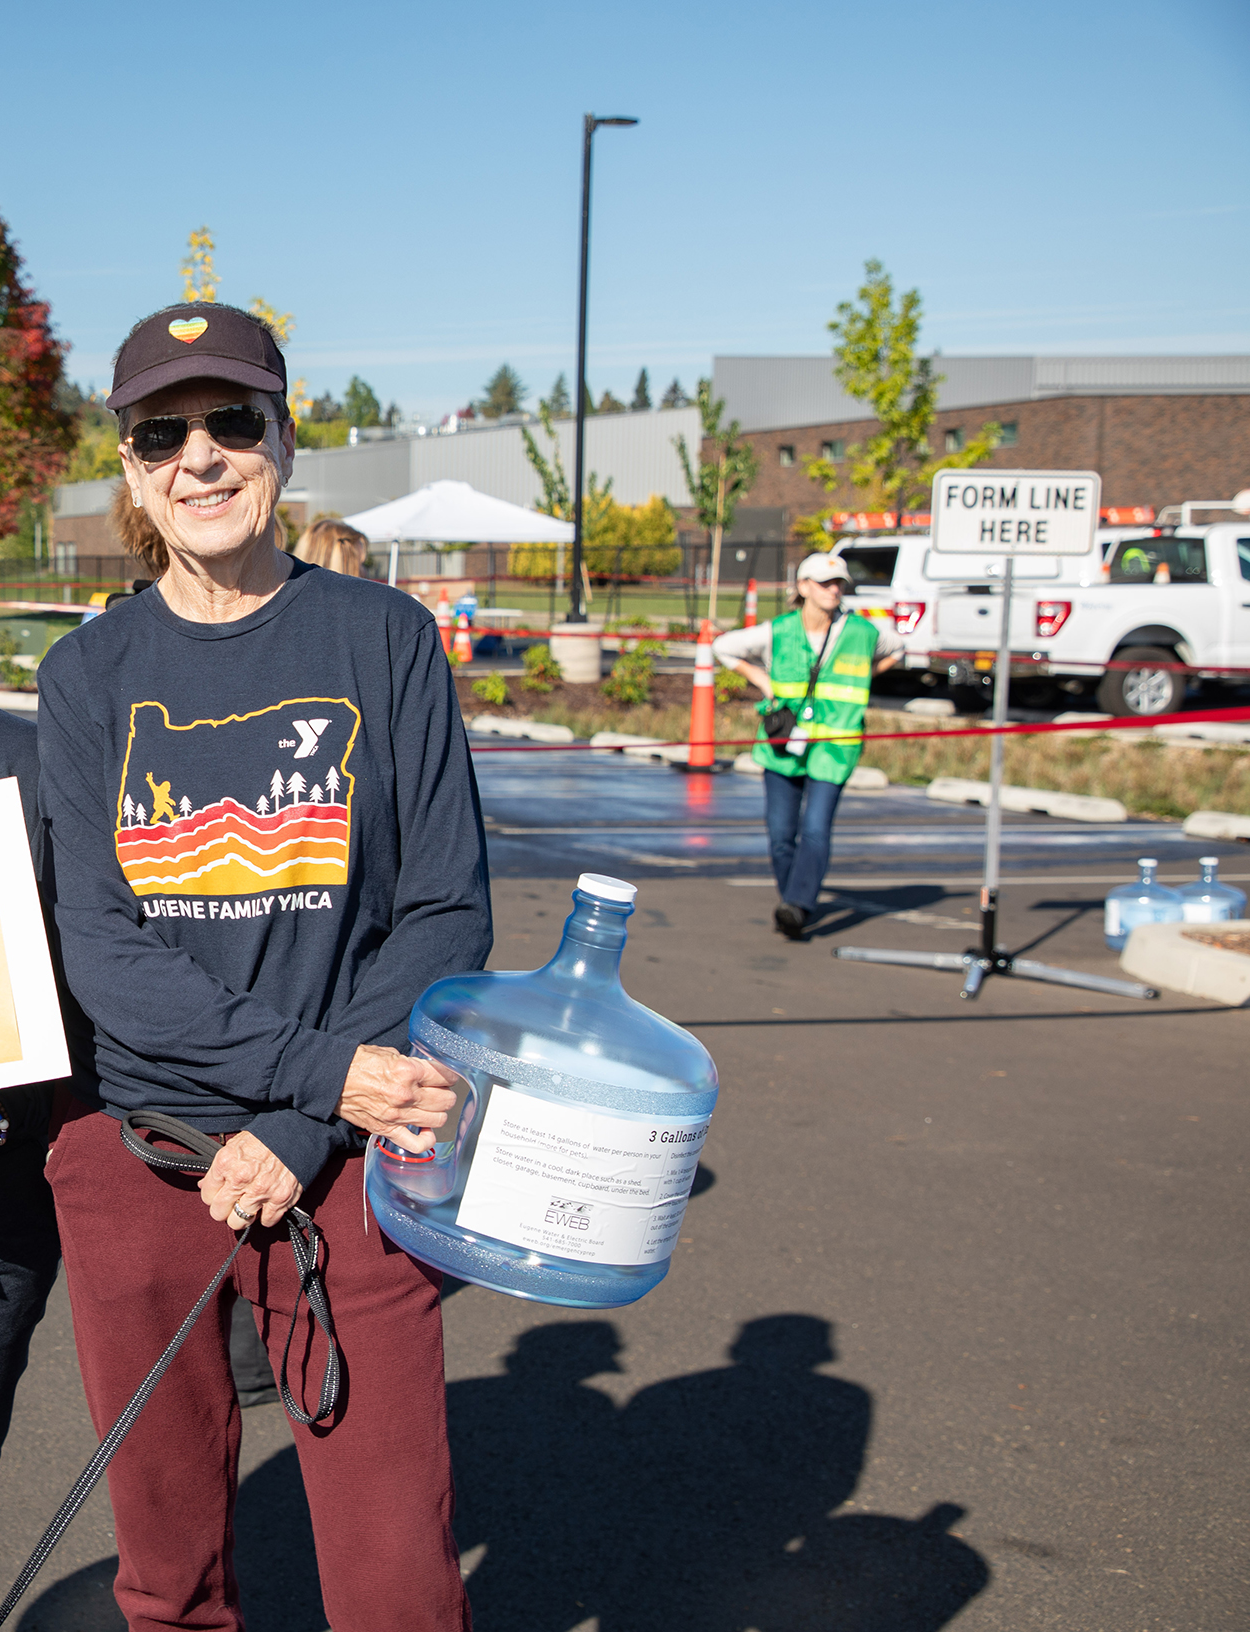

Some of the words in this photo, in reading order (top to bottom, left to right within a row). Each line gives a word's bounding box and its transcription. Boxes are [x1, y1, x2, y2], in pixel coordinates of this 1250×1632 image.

[946, 485, 1019, 509] FORM
[1030, 486, 1087, 510] LINE
[980, 520, 1049, 543] HERE
[278, 738, 296, 748] the
[141, 899, 206, 920] UGENE
[208, 896, 275, 920] FAMILY
[277, 891, 333, 912] YMCA
[500, 1128, 537, 1144] household
[538, 1140, 558, 1151] (more
[558, 1146, 568, 1154] for
[503, 1119, 520, 1130] Store
[530, 1128, 546, 1138] least
[556, 1136, 581, 1148] gallons
[582, 1142, 590, 1150] of
[592, 1146, 610, 1154] water
[622, 1150, 644, 1158] person
[648, 1130, 658, 1142] 3
[660, 1130, 697, 1144] Gallons
[496, 1146, 513, 1158] Store
[514, 1154, 534, 1164] water
[548, 1164, 564, 1174] cool,
[565, 1168, 580, 1176] dark
[582, 1172, 600, 1182] place
[600, 1176, 614, 1184] such
[515, 1164, 540, 1176] garage,
[542, 1171, 576, 1187] basement,
[578, 1181, 610, 1192] cupboard,
[610, 1187, 628, 1195] under
[544, 1210, 591, 1231] EWEB
[519, 1222, 542, 1233] Eugene
[542, 1229, 560, 1238] Water
[566, 1234, 588, 1244] Electric
[590, 1238, 605, 1246] Board
[542, 1235, 582, 1248] 541-685-7000
[523, 1236, 596, 1257] eweb.org/emergencyprep
